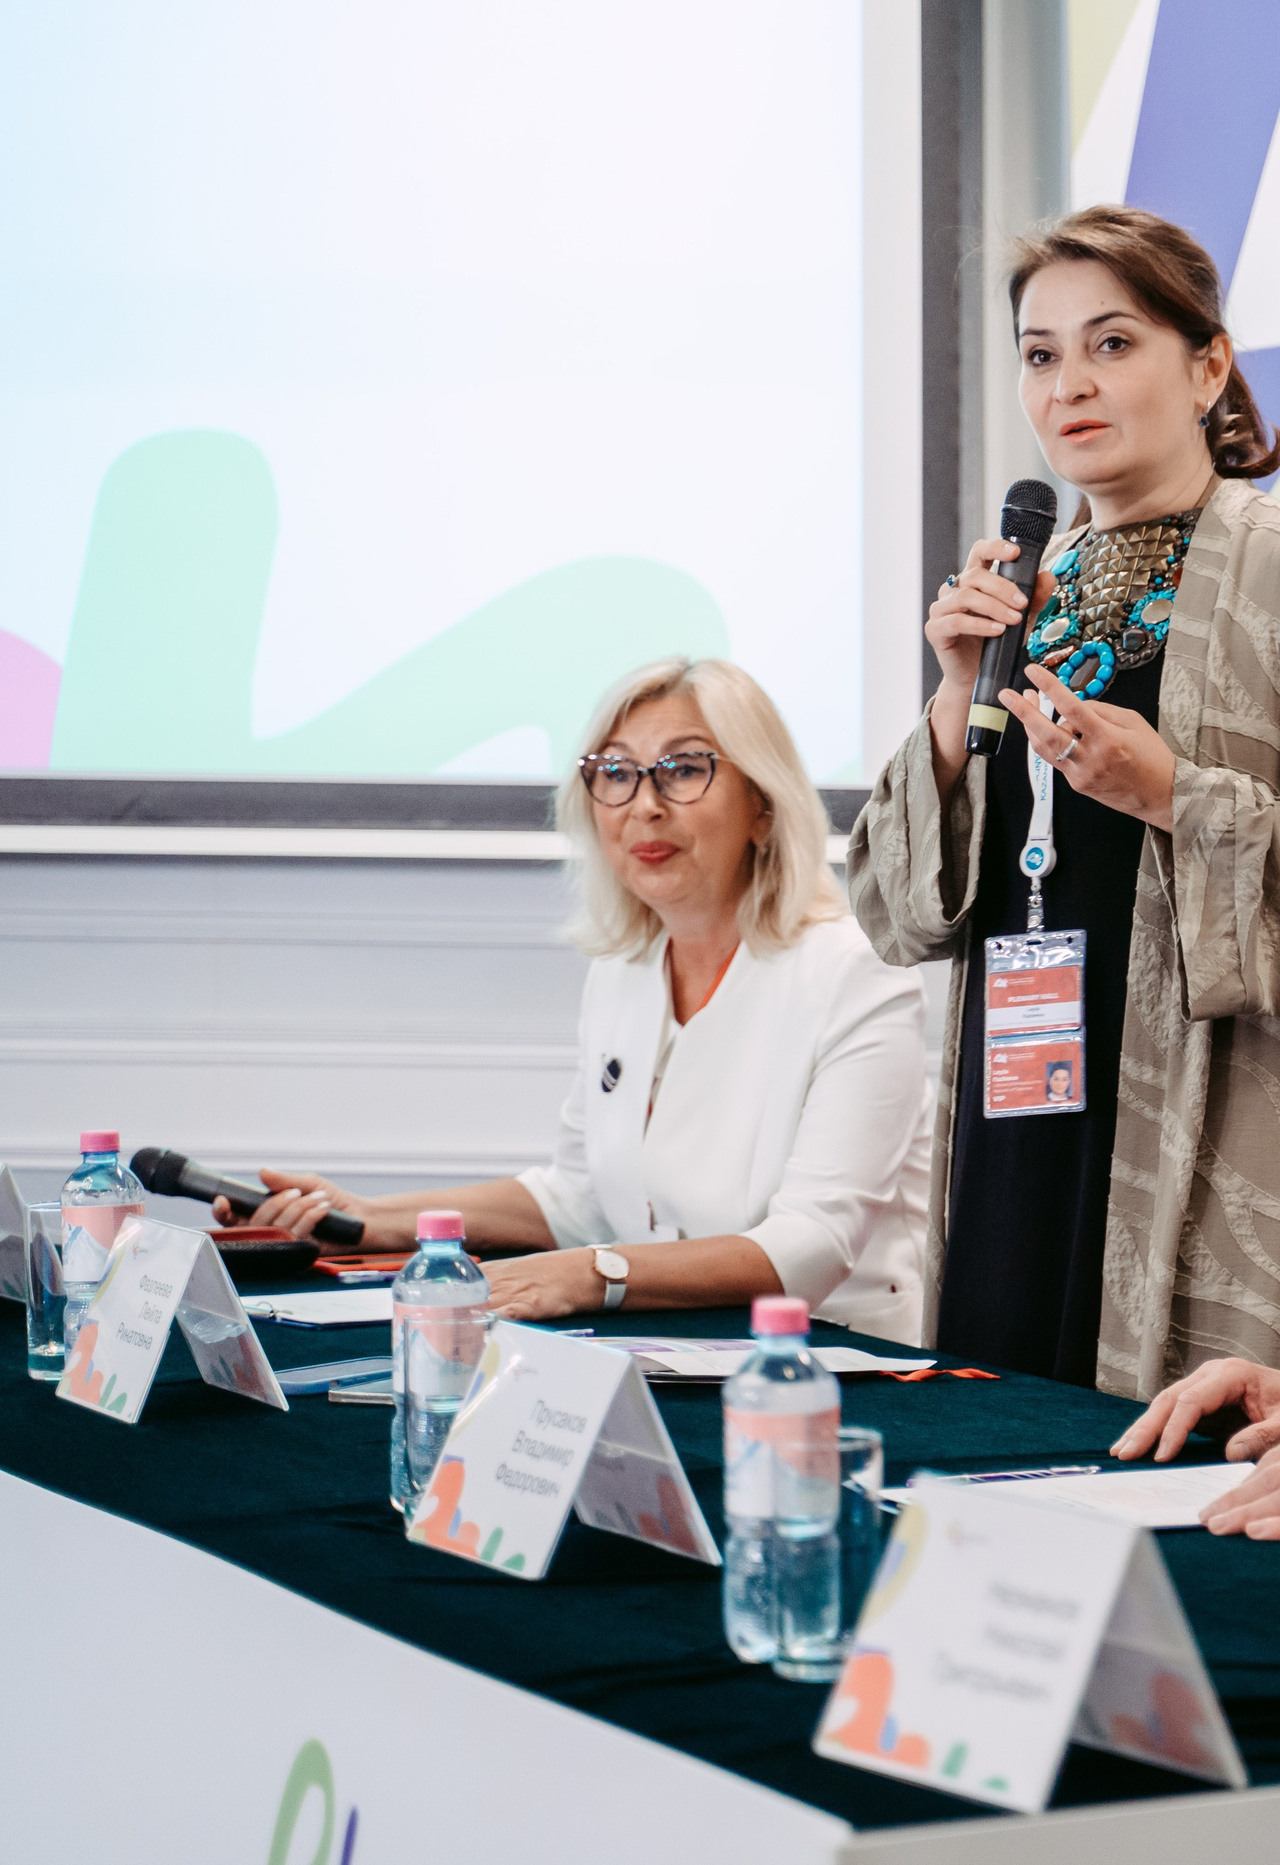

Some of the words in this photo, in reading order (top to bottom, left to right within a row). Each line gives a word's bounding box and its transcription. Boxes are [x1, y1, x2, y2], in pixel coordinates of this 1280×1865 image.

[138, 1301, 162, 1324] Лейла
[116, 1322, 153, 1350] Ринатовна
[530, 1399, 588, 1433] Прусаков
[511, 1430, 575, 1470] Владимир
[495, 1462, 561, 1498] Федорович
